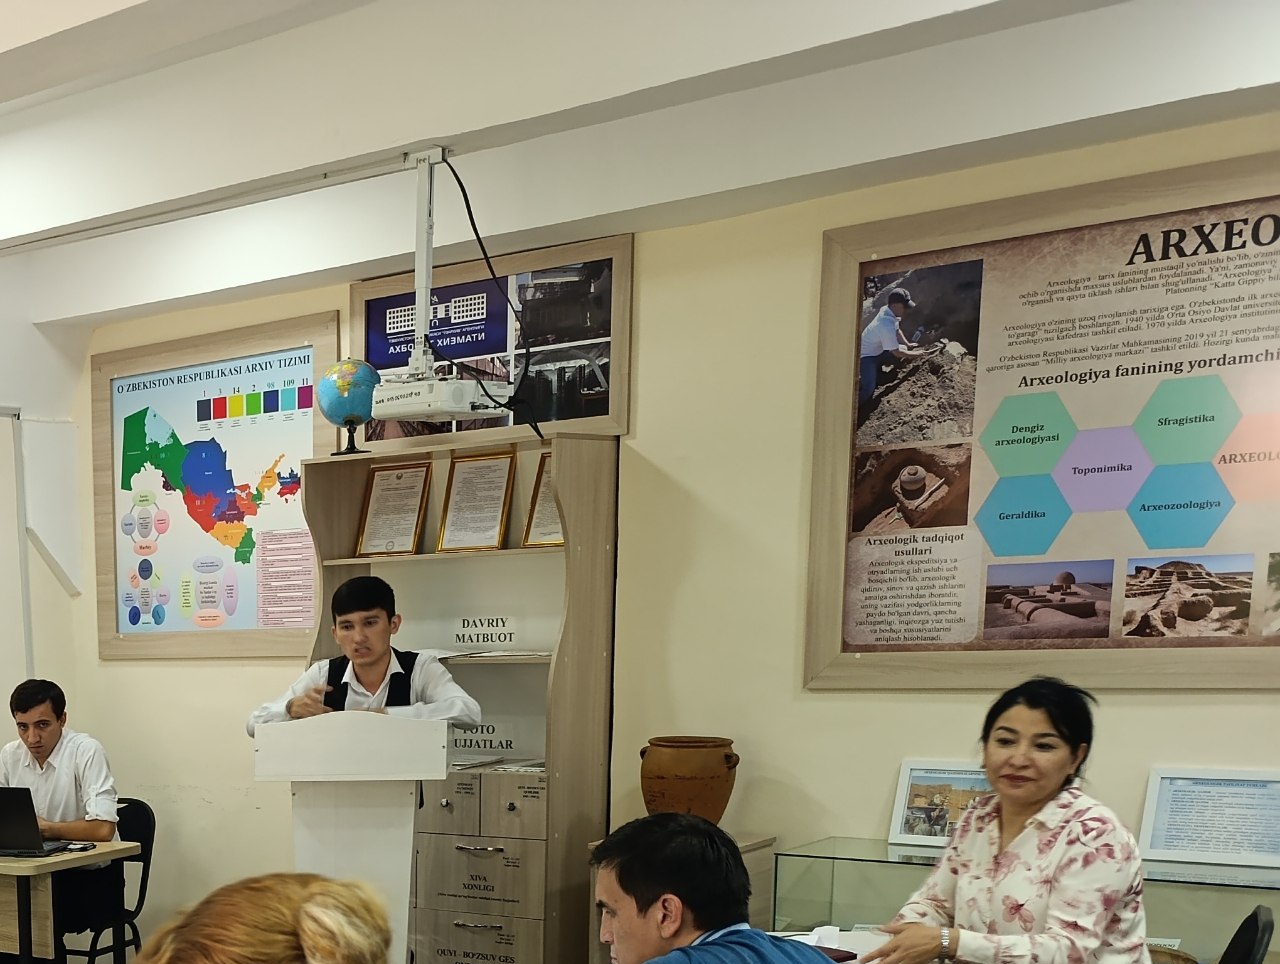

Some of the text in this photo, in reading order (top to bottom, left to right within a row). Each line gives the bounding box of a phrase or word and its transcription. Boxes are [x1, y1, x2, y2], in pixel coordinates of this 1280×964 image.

[1125, 214, 1280, 266] ARXEO
[1019, 290, 1039, 300] ochib
[1083, 282, 1110, 290] maxsus
[1112, 274, 1157, 286] uslublardan
[1234, 259, 1277, 270] zamonaviy
[1047, 277, 1091, 287] Arxeologiya
[1117, 268, 1149, 278] fanining
[1151, 262, 1184, 273] mustaqil
[1166, 284, 1207, 296] Platonning
[1238, 276, 1265, 286] Gippiy
[1066, 293, 1086, 302] qayta
[1088, 288, 1112, 298] tiklash
[1115, 285, 1138, 294] ishlari
[1003, 322, 1046, 332] Arxeologiya
[1098, 309, 1138, 320] rivojlanish
[1140, 305, 1168, 314] tarixiga
[1044, 324, 1076, 334] tuzilgach
[1126, 316, 1144, 324] 1940
[1146, 314, 1165, 322] yilda
[1188, 308, 1212, 316] Osiyo
[1214, 304, 1240, 314] Davlat
[1008, 336, 1054, 346] arxeologiyasi
[1056, 332, 1089, 340] kafedrasi
[1092, 326, 1116, 336] tashkil
[1147, 321, 1165, 329] 1970
[1168, 319, 1186, 328] yilda
[1188, 314, 1237, 324] Arxeologiya
[436, 332, 485, 347] ХИЗМАТИ
[1042, 347, 1088, 358] Respublikasi
[1090, 344, 1119, 352] Vazirlar
[1122, 336, 1182, 348] Mahkamasining
[1184, 332, 1204, 342] 2019
[1206, 331, 1216, 340] yil
[1219, 330, 1228, 338] 21
[986, 364, 1014, 373] qaroriga
[1070, 352, 1112, 362] arxeologiya
[1150, 344, 1176, 353] tashkil
[1204, 338, 1232, 346] Hozirgi
[1236, 336, 1260, 344] kunda
[178, 366, 242, 385] RESPUBLIKASI
[244, 360, 274, 374] ARXIV
[277, 354, 310, 369] TIZIMI
[1018, 368, 1110, 388] Arxeologiya
[1116, 361, 1184, 378] fanining
[232, 386, 240, 394] 14
[252, 384, 256, 392] 2
[283, 379, 295, 388] 109
[302, 378, 308, 386] 11
[1158, 414, 1215, 426] Sfragistika
[1012, 424, 1045, 434] Dengiz
[995, 434, 1060, 446] arxeologiyasi
[1072, 463, 1132, 476] Toponimika
[1139, 500, 1221, 512] Arxeozoologiya
[999, 510, 1046, 520] Geraldika
[865, 533, 964, 546] Arxeologik tadqiqot
[894, 546, 932, 557] usullari
[868, 560, 904, 568] Arxeologik
[907, 558, 948, 566] ekspeditsiya
[868, 568, 910, 576] otryadlarning
[924, 566, 944, 574] uslubi
[868, 576, 897, 584] bosqichli
[922, 574, 956, 582] arxeologik
[886, 584, 903, 592] sinov
[916, 584, 936, 592] qazish
[938, 582, 966, 590] ishlarini
[888, 592, 926, 600] oshirishdan
[860, 602, 878, 610] uning
[866, 610, 886, 618] paydo
[933, 608, 957, 616] qancha
[462, 617, 508, 628] DAVRIY
[898, 618, 929, 626] inqirozga
[904, 626, 952, 634] xususiyatlarini
[456, 632, 514, 644] MATBUOT
[875, 636, 902, 644] aniqlash
[454, 738, 514, 750] UJJATLAR
[470, 874, 487, 882] XIVA
[462, 882, 494, 892] XONLIGI
[436, 948, 456, 957] QUYI
[498, 956, 516, 964] GES
